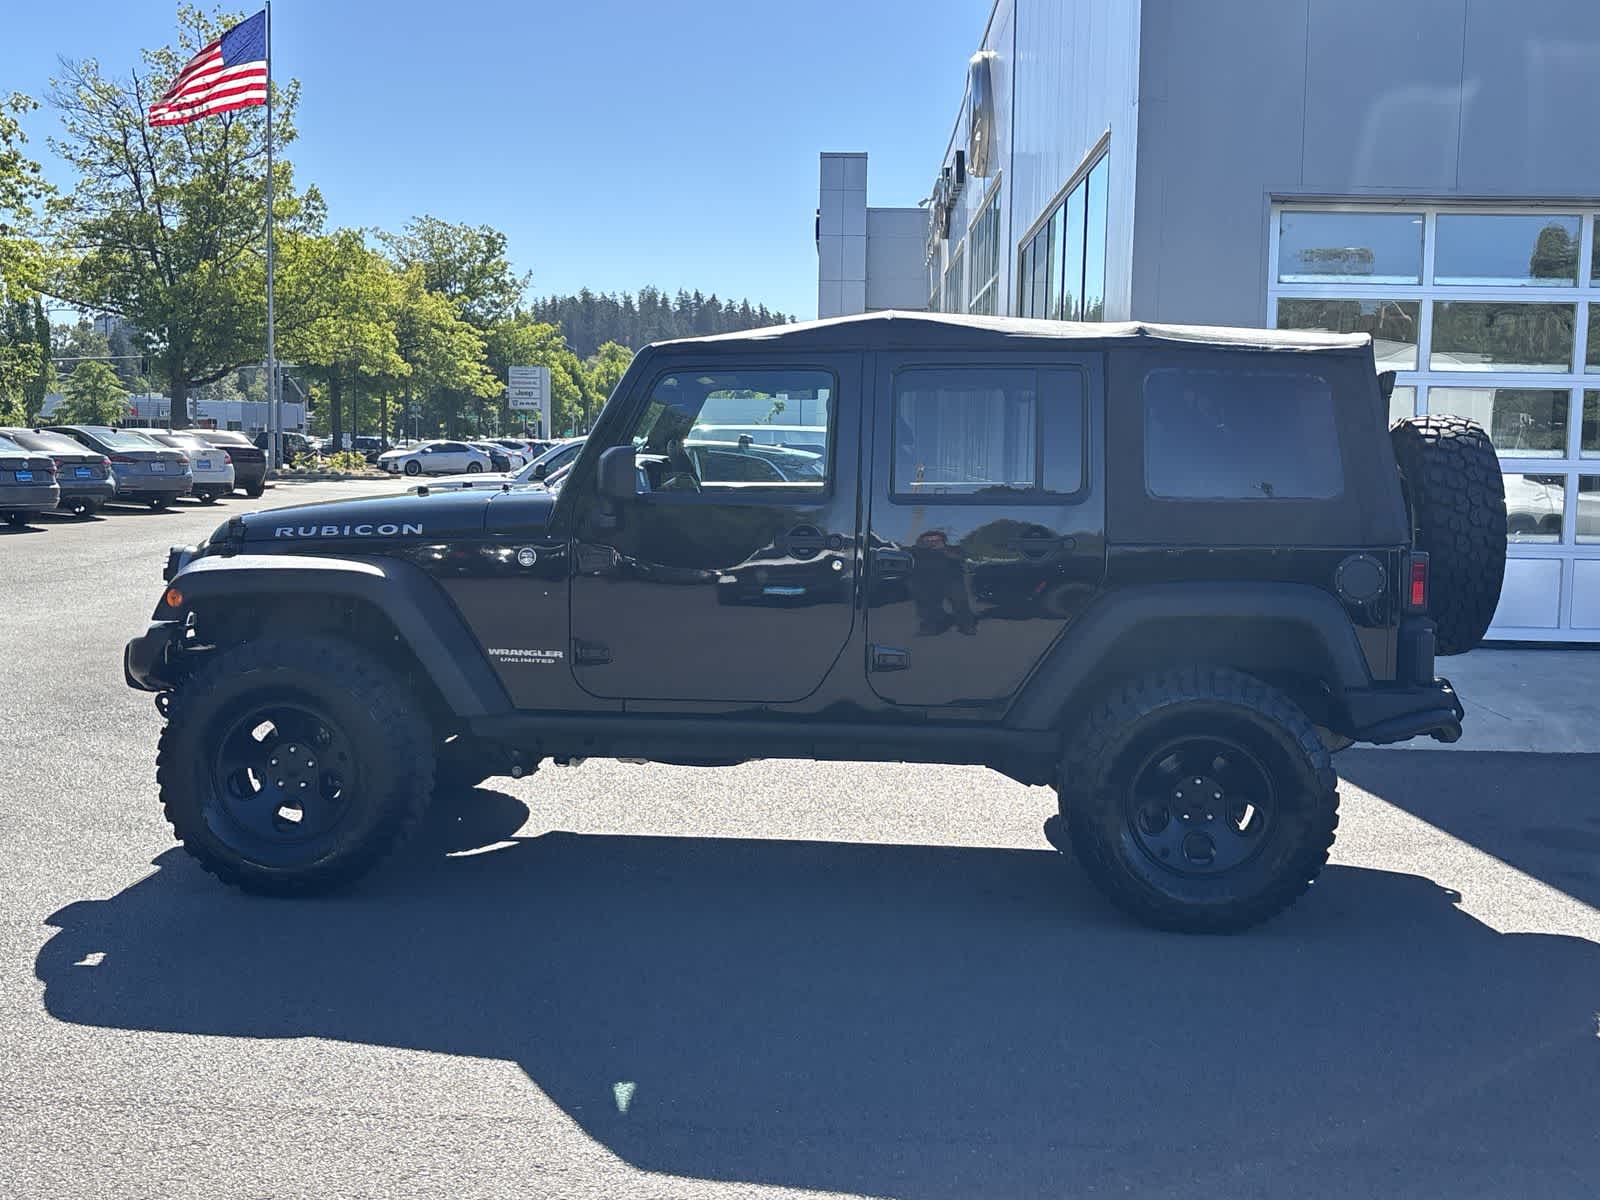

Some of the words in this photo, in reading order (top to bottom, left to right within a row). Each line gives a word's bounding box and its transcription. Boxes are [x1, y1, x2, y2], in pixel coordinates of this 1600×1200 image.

[275, 523, 423, 537] RUBICON
[488, 648, 564, 658] WRANGLER
[500, 656, 555, 664] UNLIMITED
